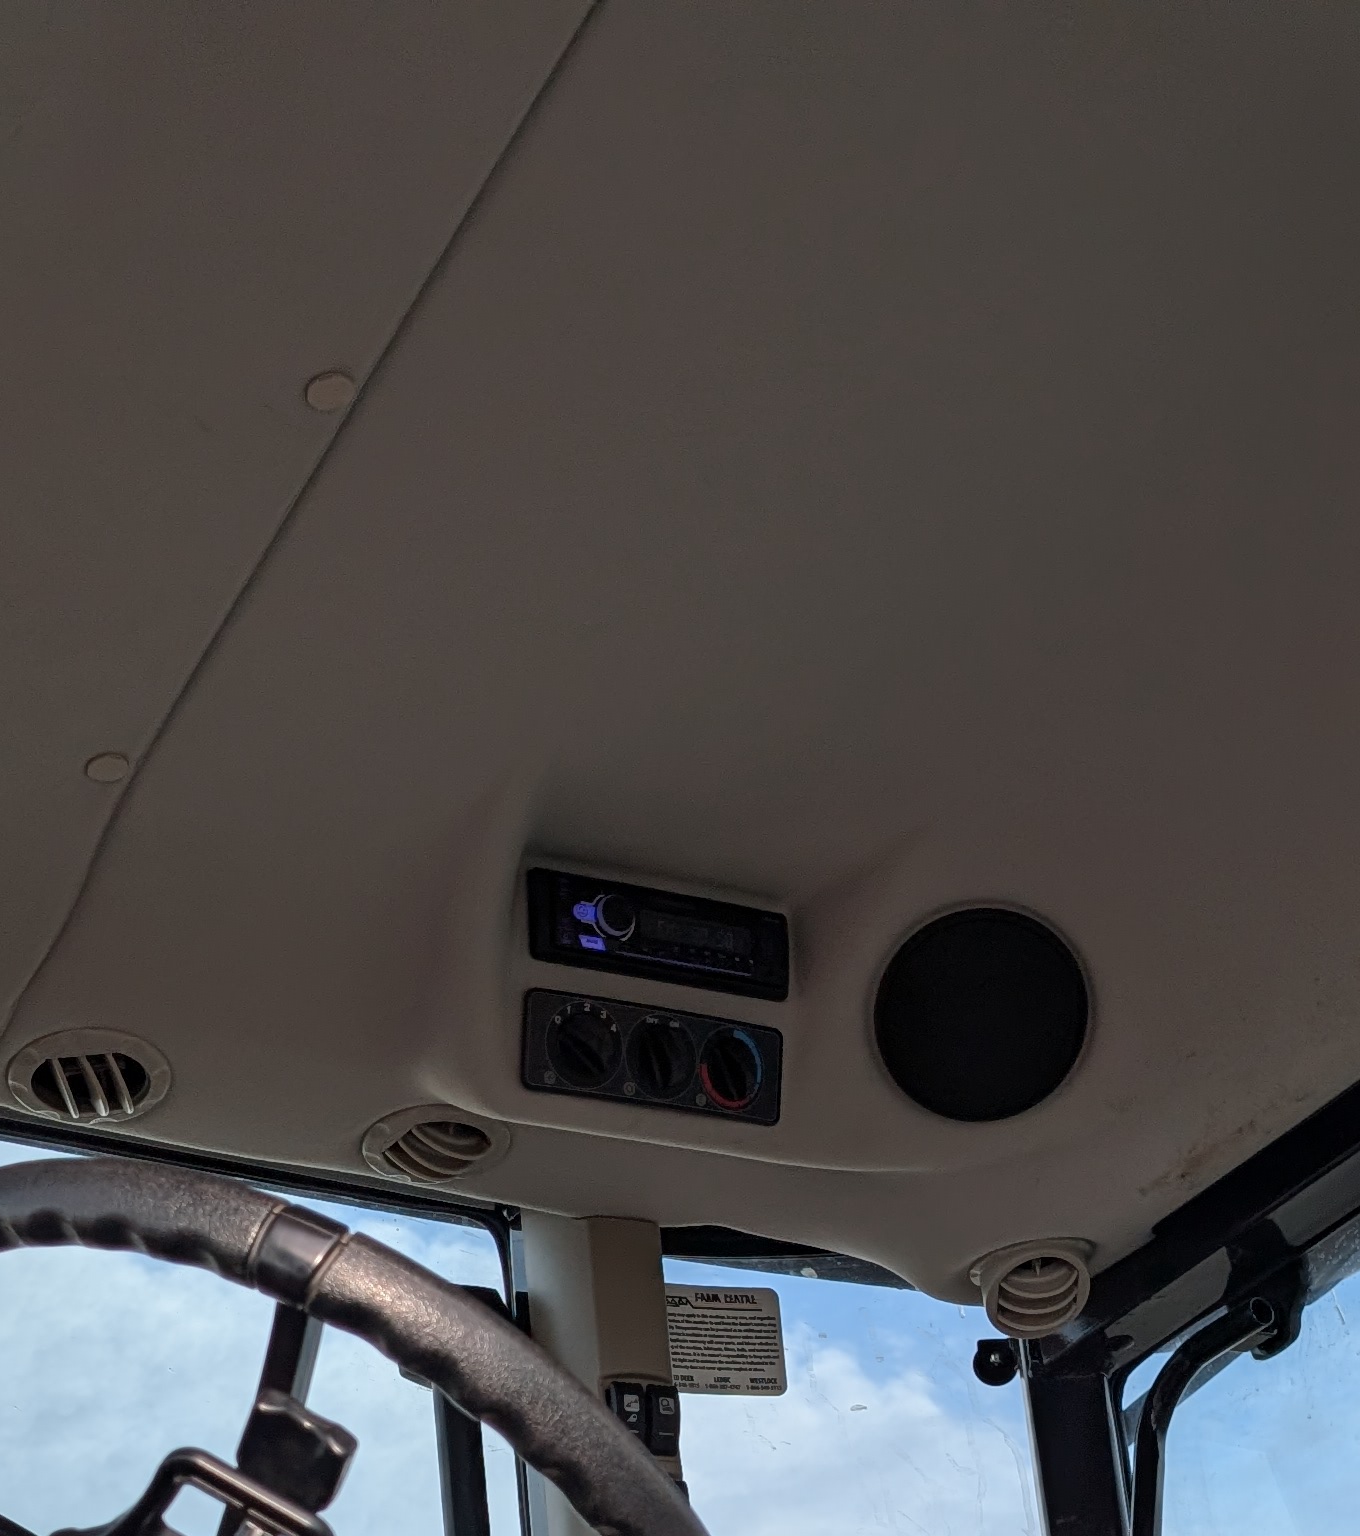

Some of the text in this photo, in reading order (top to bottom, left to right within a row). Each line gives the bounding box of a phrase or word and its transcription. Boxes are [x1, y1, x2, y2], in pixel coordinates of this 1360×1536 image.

[566, 1005, 572, 1014] 1
[583, 1003, 591, 1012] 2
[600, 1010, 607, 1019] 3
[610, 1023, 617, 1033] 4
[646, 1016, 659, 1025] OFF
[669, 1018, 680, 1028] ON
[694, 1292, 721, 1303] FARM
